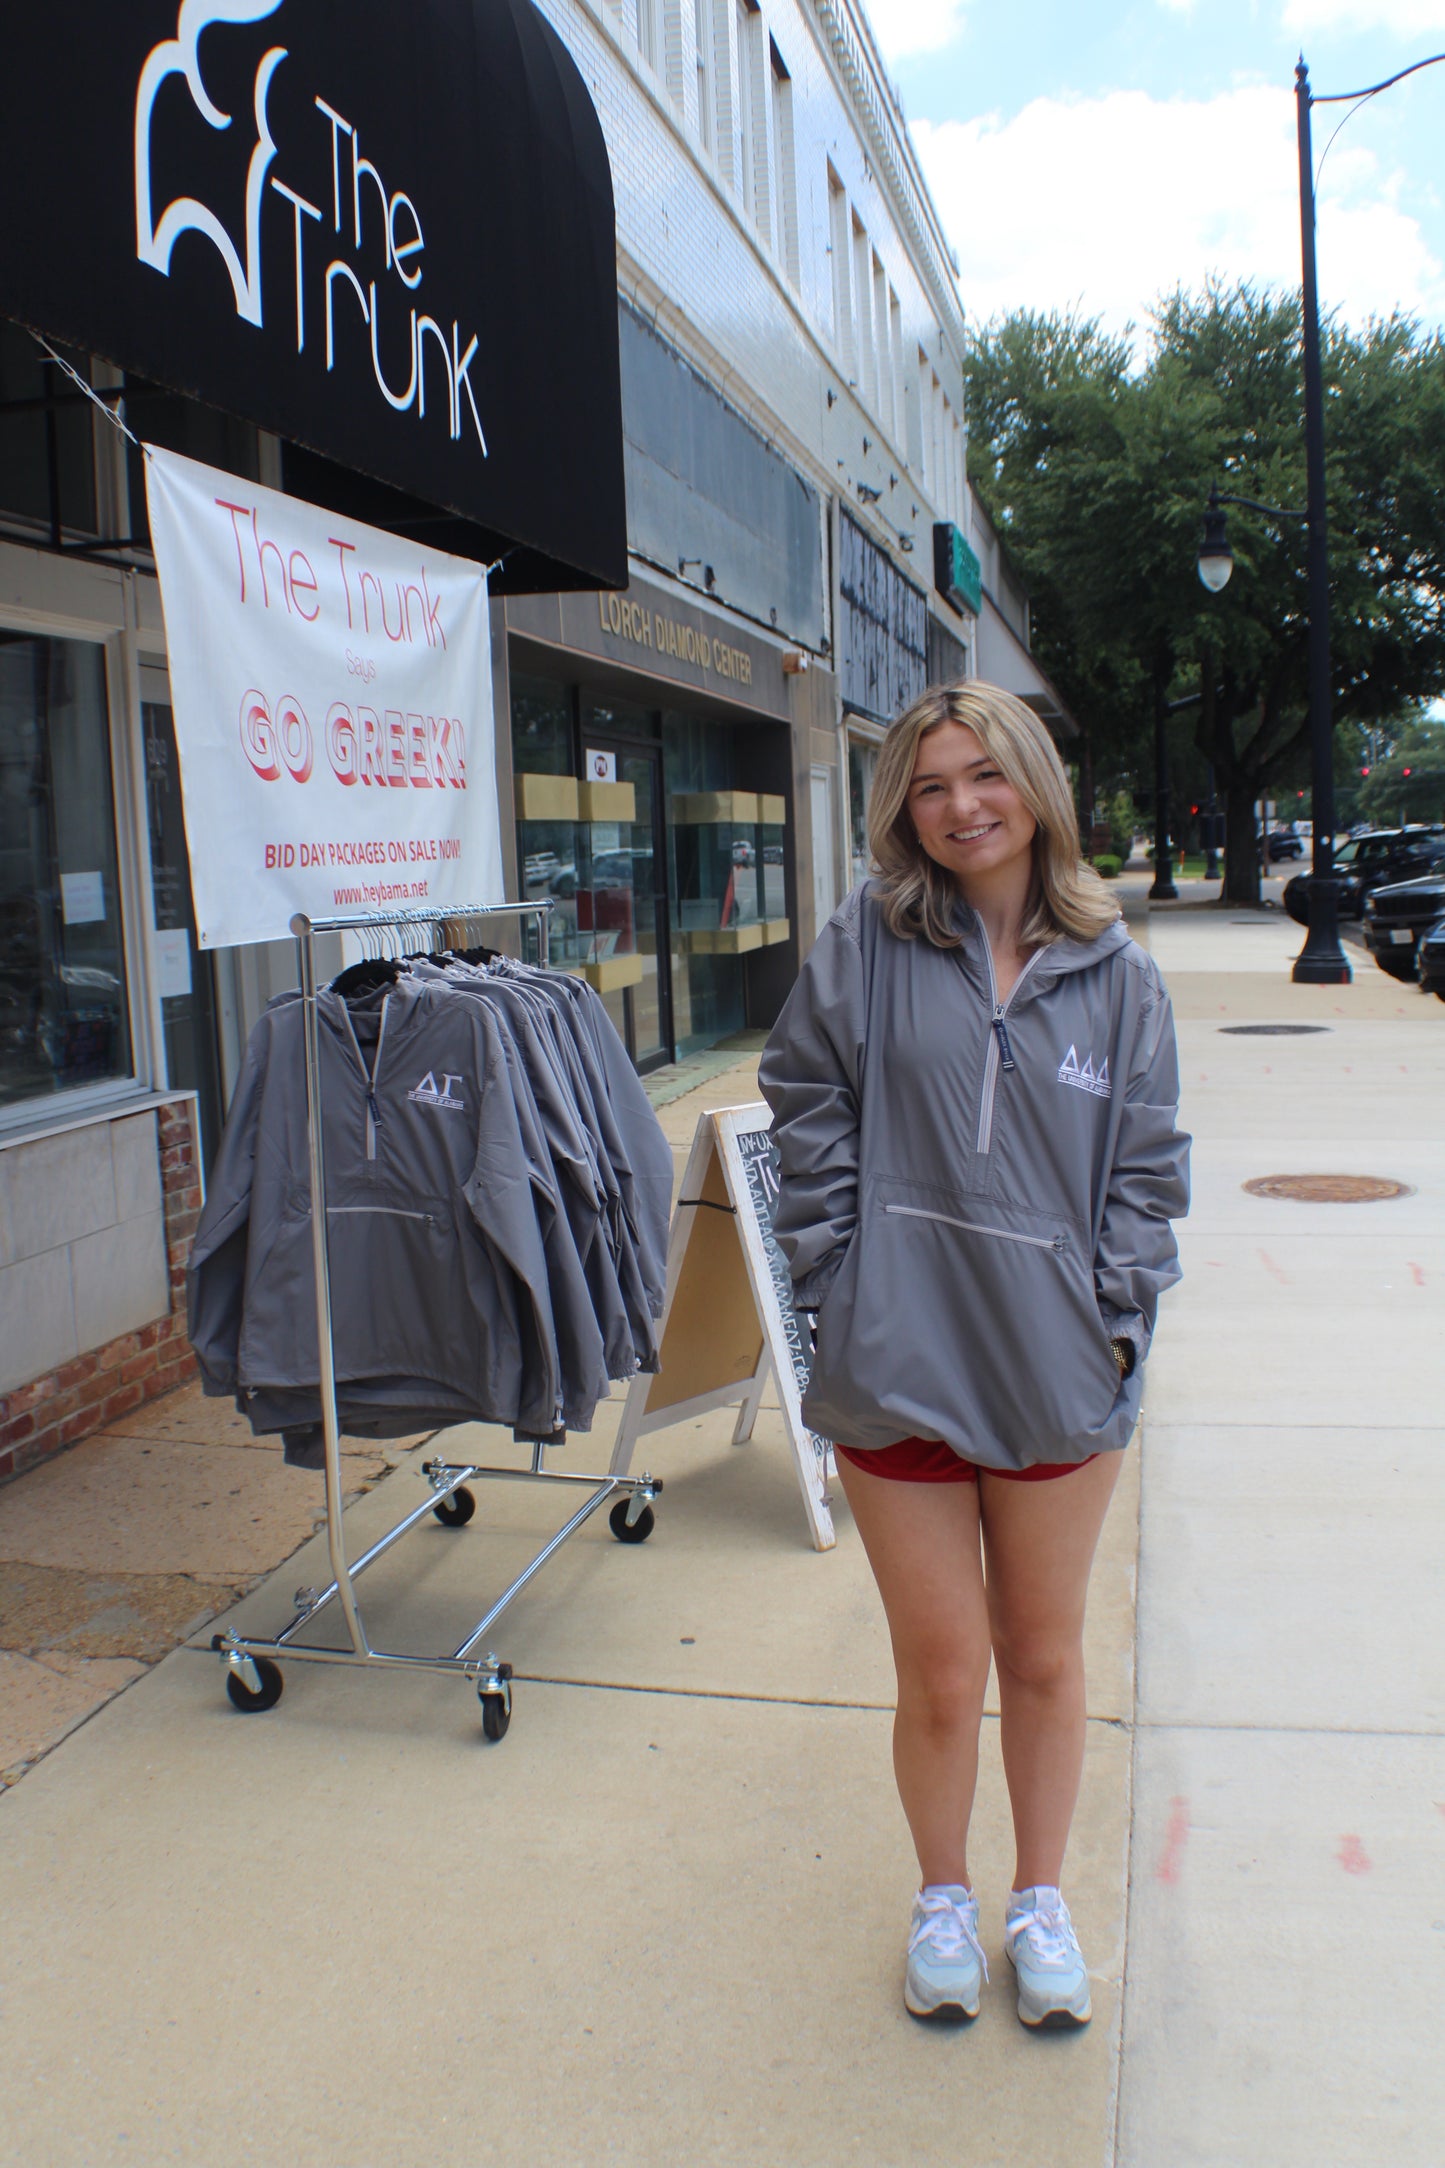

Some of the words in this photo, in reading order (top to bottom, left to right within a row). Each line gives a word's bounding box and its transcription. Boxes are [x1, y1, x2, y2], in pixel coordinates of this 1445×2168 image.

[315, 95, 425, 290] The
[271, 177, 488, 459] Trunk
[215, 498, 320, 622] The
[328, 537, 447, 651] Trunk
[345, 648, 376, 684] Says
[599, 591, 652, 648] LORCH
[655, 614, 711, 670] DIAMOND
[713, 638, 752, 685] CENTER
[239, 688, 313, 784] GO
[325, 701, 467, 789] GREEK!
[264, 844, 295, 869] BID
[300, 843, 326, 868] DAY
[328, 841, 387, 867] PACKAGES
[388, 841, 407, 863] ON
[410, 840, 437, 862] SALE
[439, 839, 461, 861] NOW!
[333, 880, 429, 907] www.heybama.net
